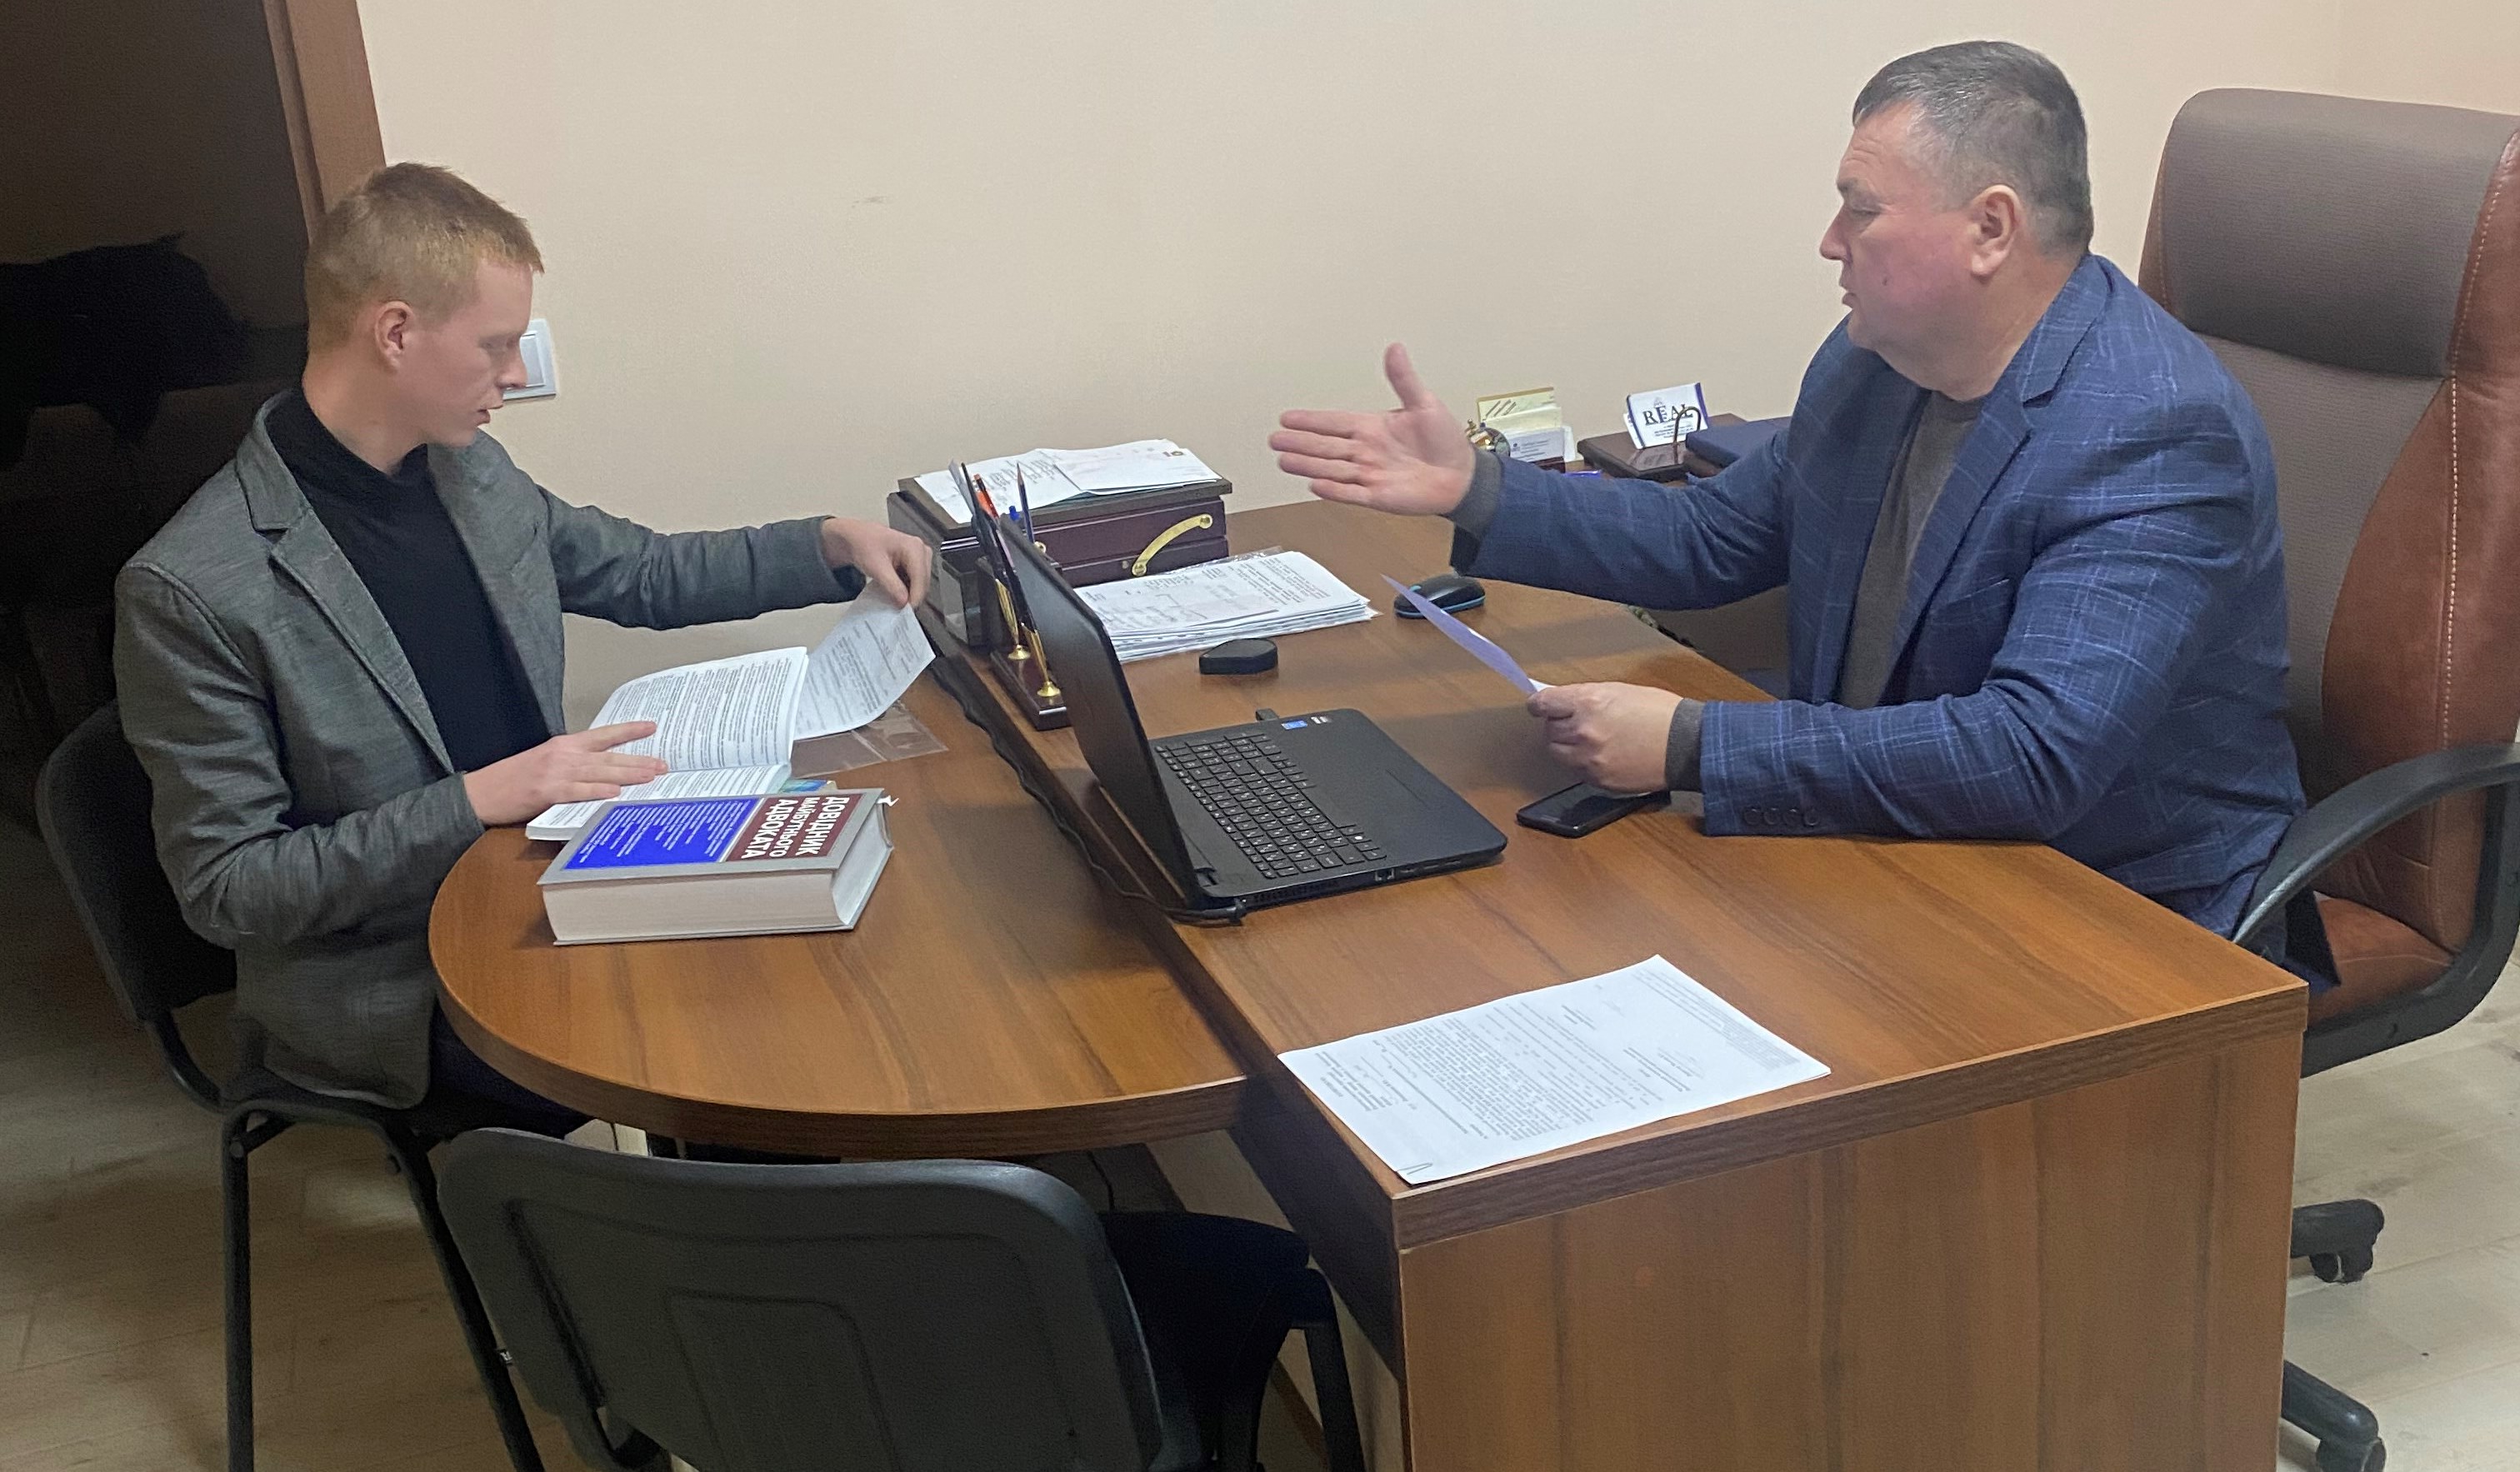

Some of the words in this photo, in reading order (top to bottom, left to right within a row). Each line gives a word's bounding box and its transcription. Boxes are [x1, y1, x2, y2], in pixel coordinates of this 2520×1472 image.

[1642, 403, 1694, 426] REAL
[741, 799, 799, 859] АДВОКАТА
[768, 796, 821, 857] МАЙБУТНЬОГО
[795, 796, 850, 856] ДОВІДНИК
